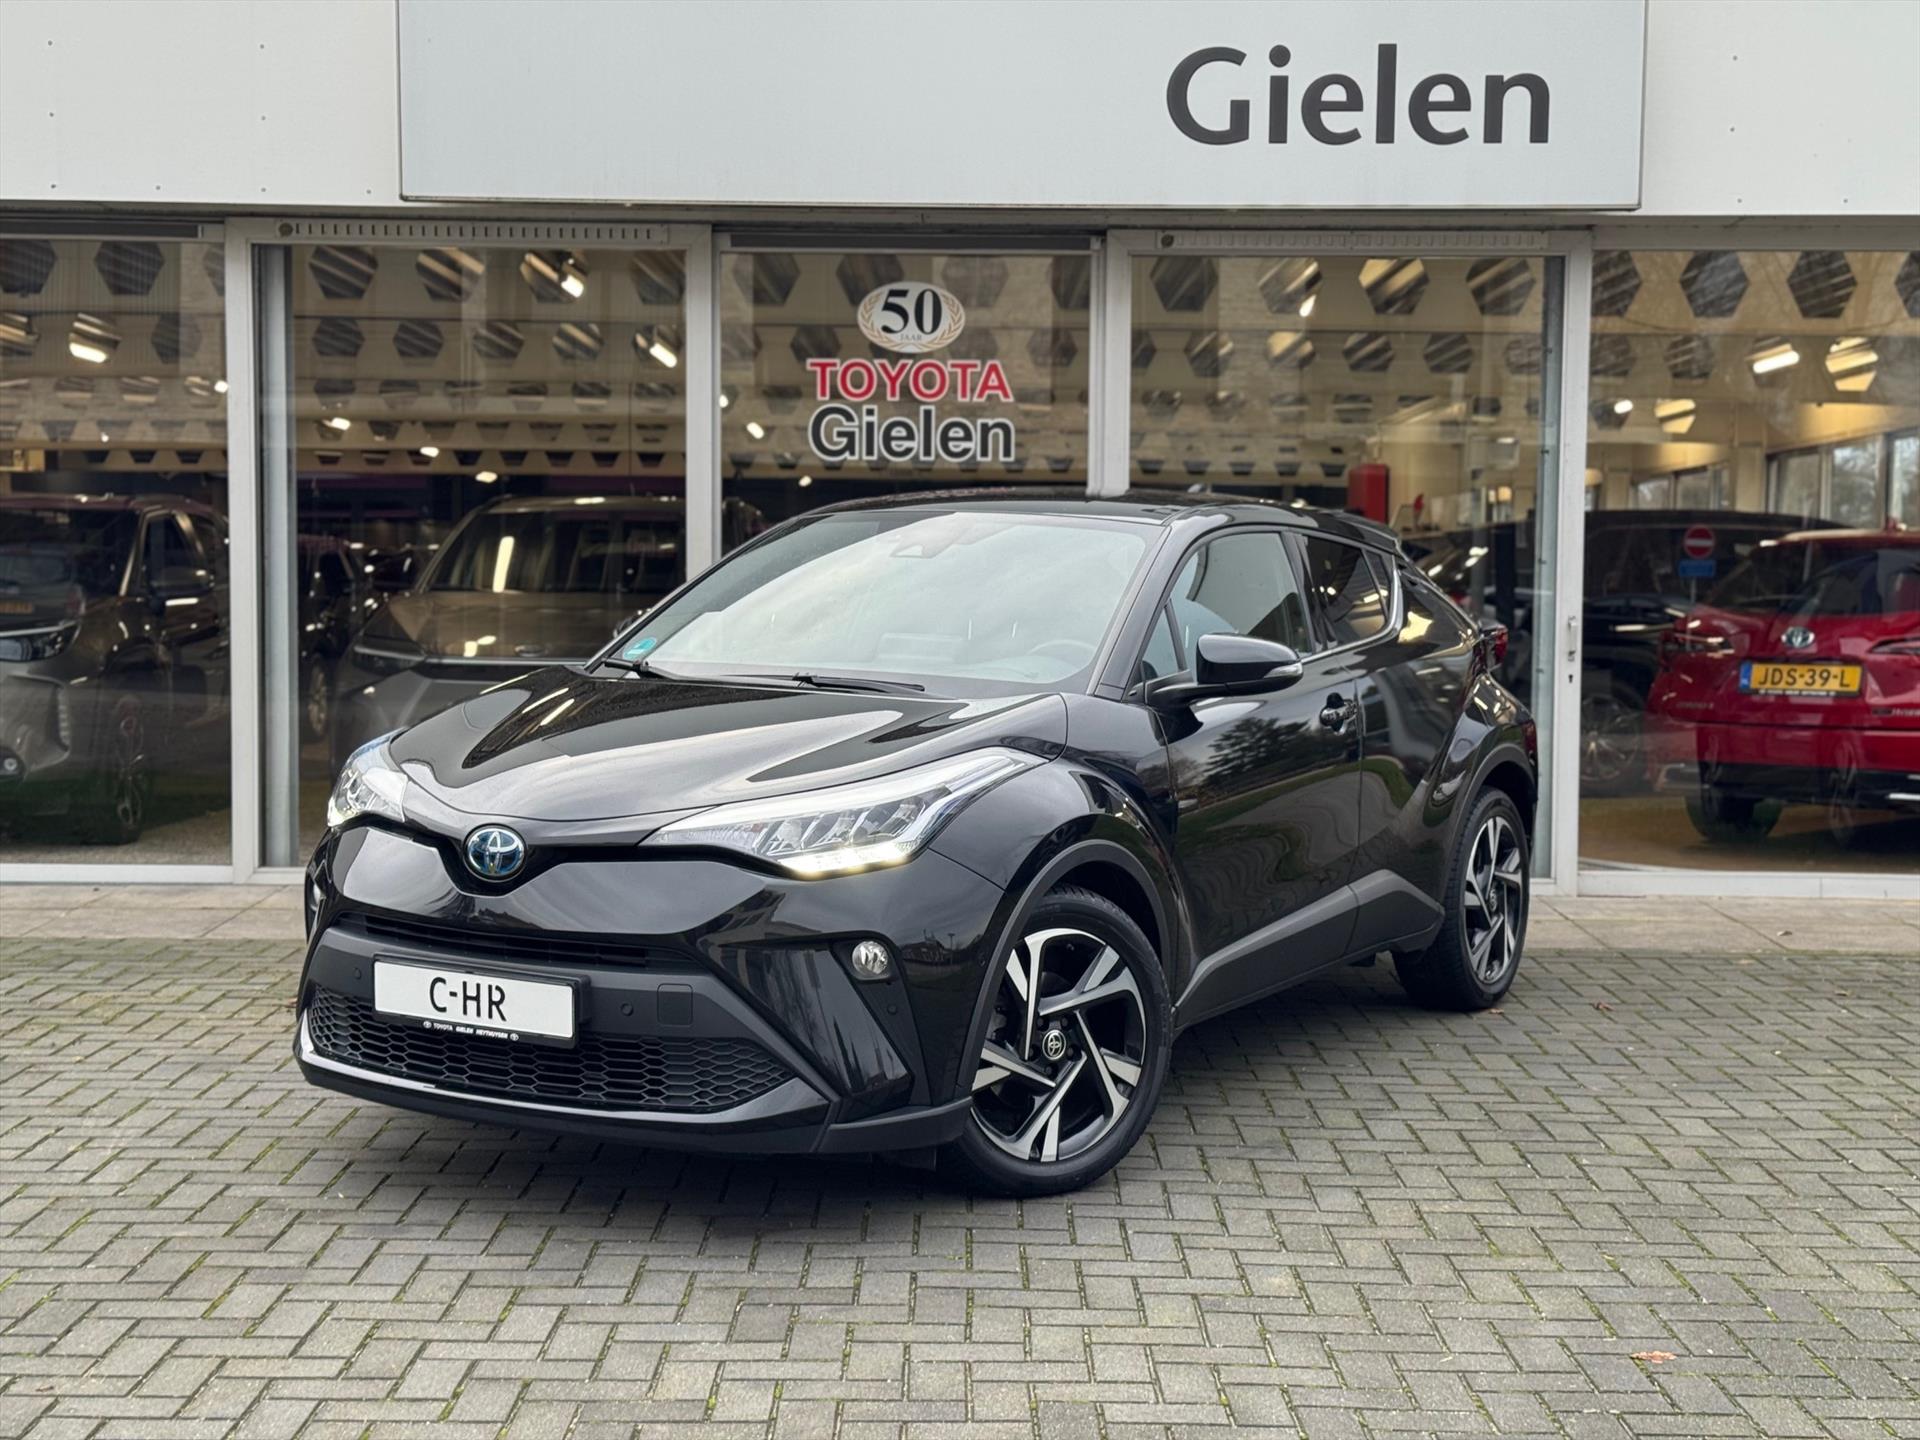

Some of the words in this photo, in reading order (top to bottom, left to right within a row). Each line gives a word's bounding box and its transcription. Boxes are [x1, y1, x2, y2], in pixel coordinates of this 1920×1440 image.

[1166, 43, 1550, 145] Gielen
[880, 288, 943, 335] 50
[900, 333, 922, 342] JAAR
[807, 360, 1013, 401] TOYOTA
[808, 404, 1015, 461] Gielen
[1757, 667, 1851, 688] JDS-39-L
[429, 976, 507, 1022] C-HR
[433, 1022, 453, 1031] TOYOTA
